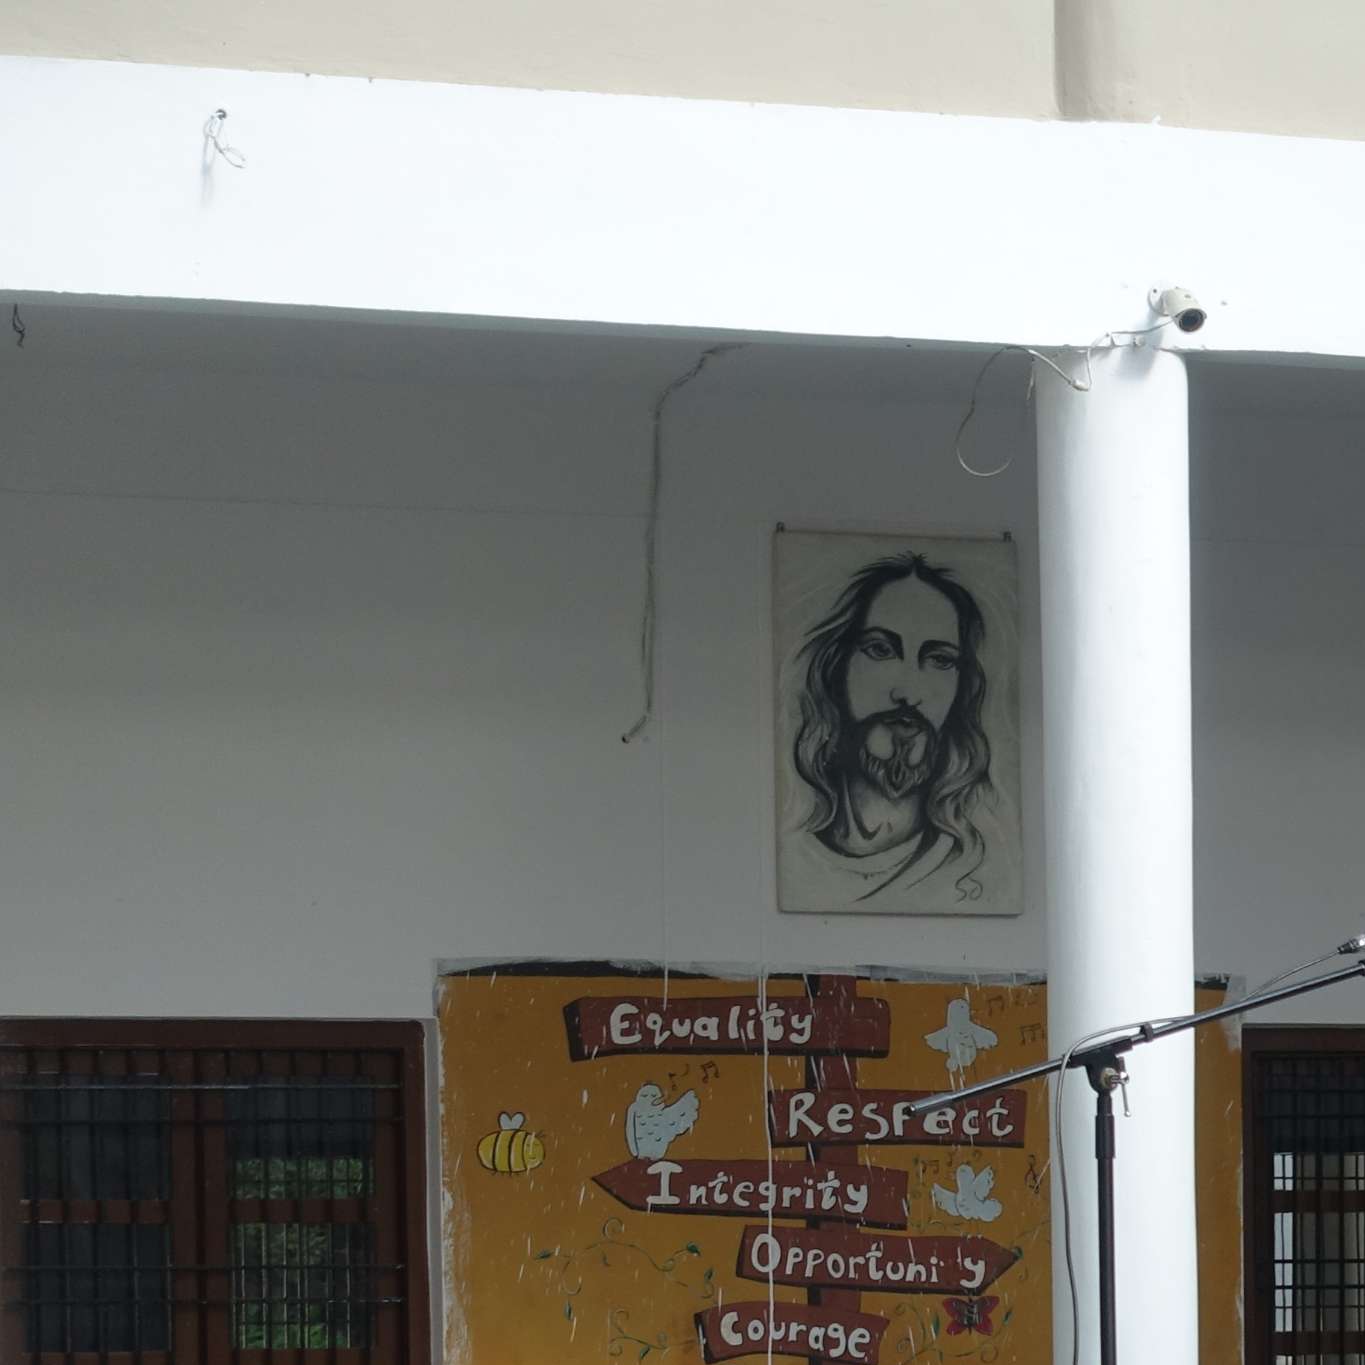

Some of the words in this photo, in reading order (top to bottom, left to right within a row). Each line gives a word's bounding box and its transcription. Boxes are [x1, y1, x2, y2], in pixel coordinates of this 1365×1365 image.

[609, 1002, 815, 1045] Equality
[646, 1160, 869, 1215] Integrity
[750, 1233, 986, 1289] Opportuniy
[720, 1310, 872, 1359] Courage
